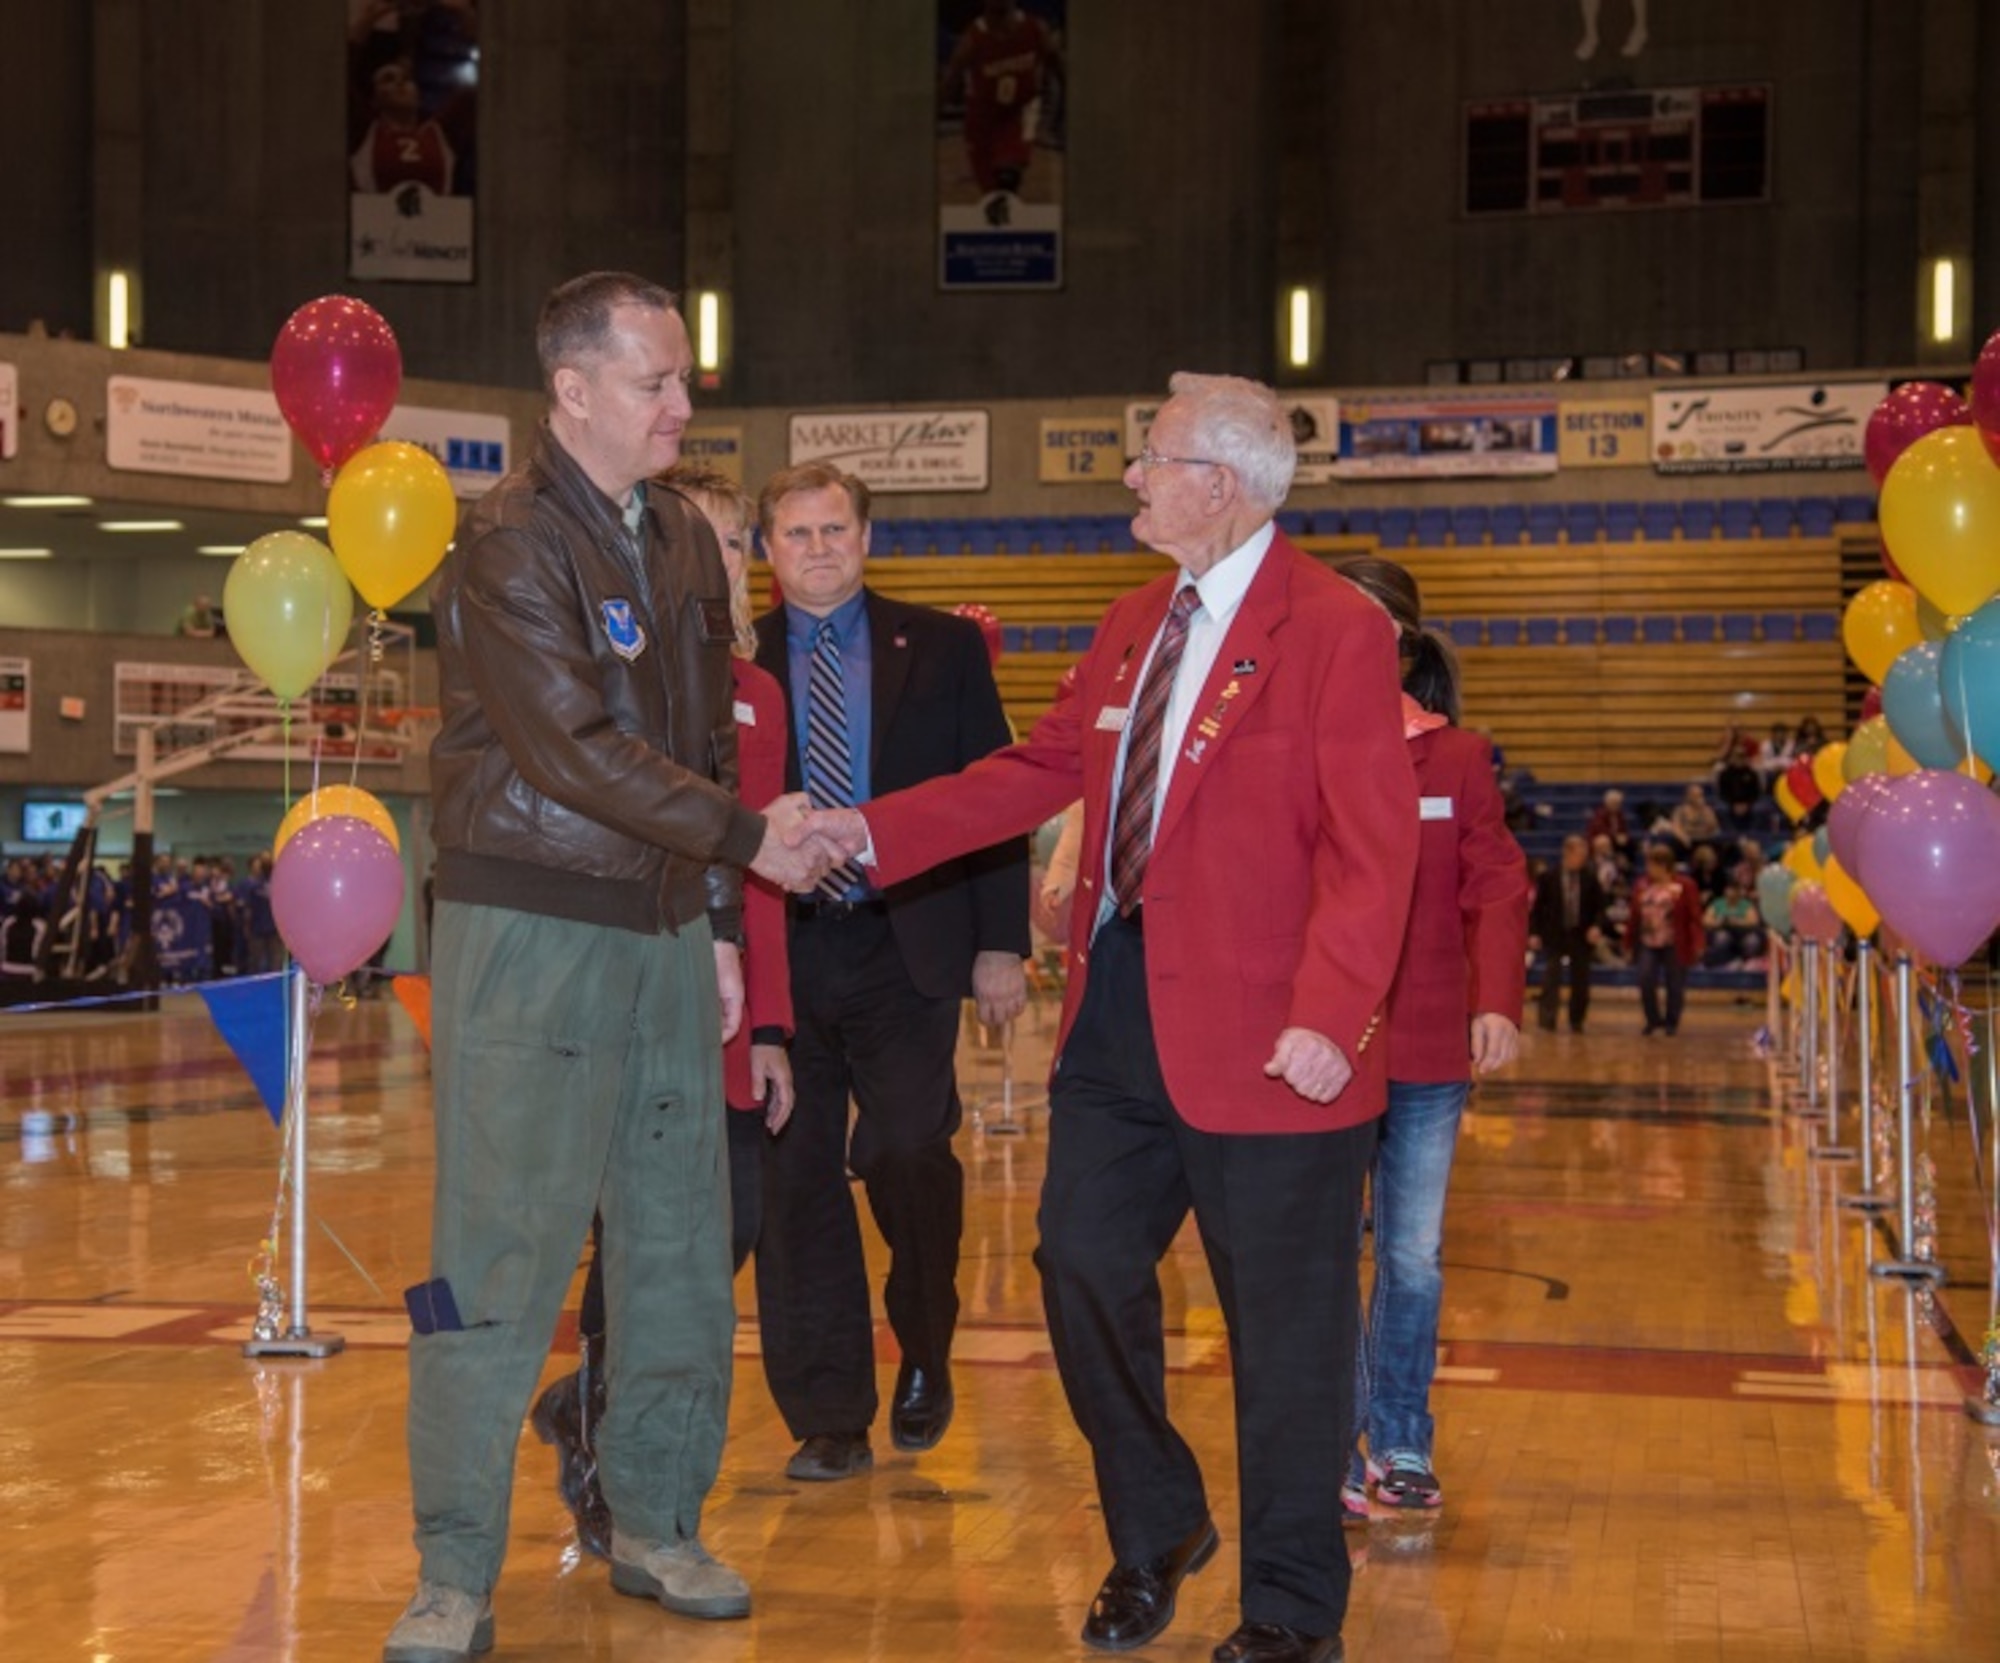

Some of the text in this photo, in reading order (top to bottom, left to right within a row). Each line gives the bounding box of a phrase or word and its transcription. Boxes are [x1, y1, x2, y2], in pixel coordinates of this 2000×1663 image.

[396, 136, 423, 163] 2
[1565, 411, 1645, 432] SECTION
[794, 421, 898, 446] MARKET
[1045, 430, 1118, 449] SECTION
[679, 439, 737, 455] ECTION
[1588, 432, 1619, 459] 13
[860, 456, 963, 470] FOOD & DRUG
[1067, 451, 1094, 474] 12
